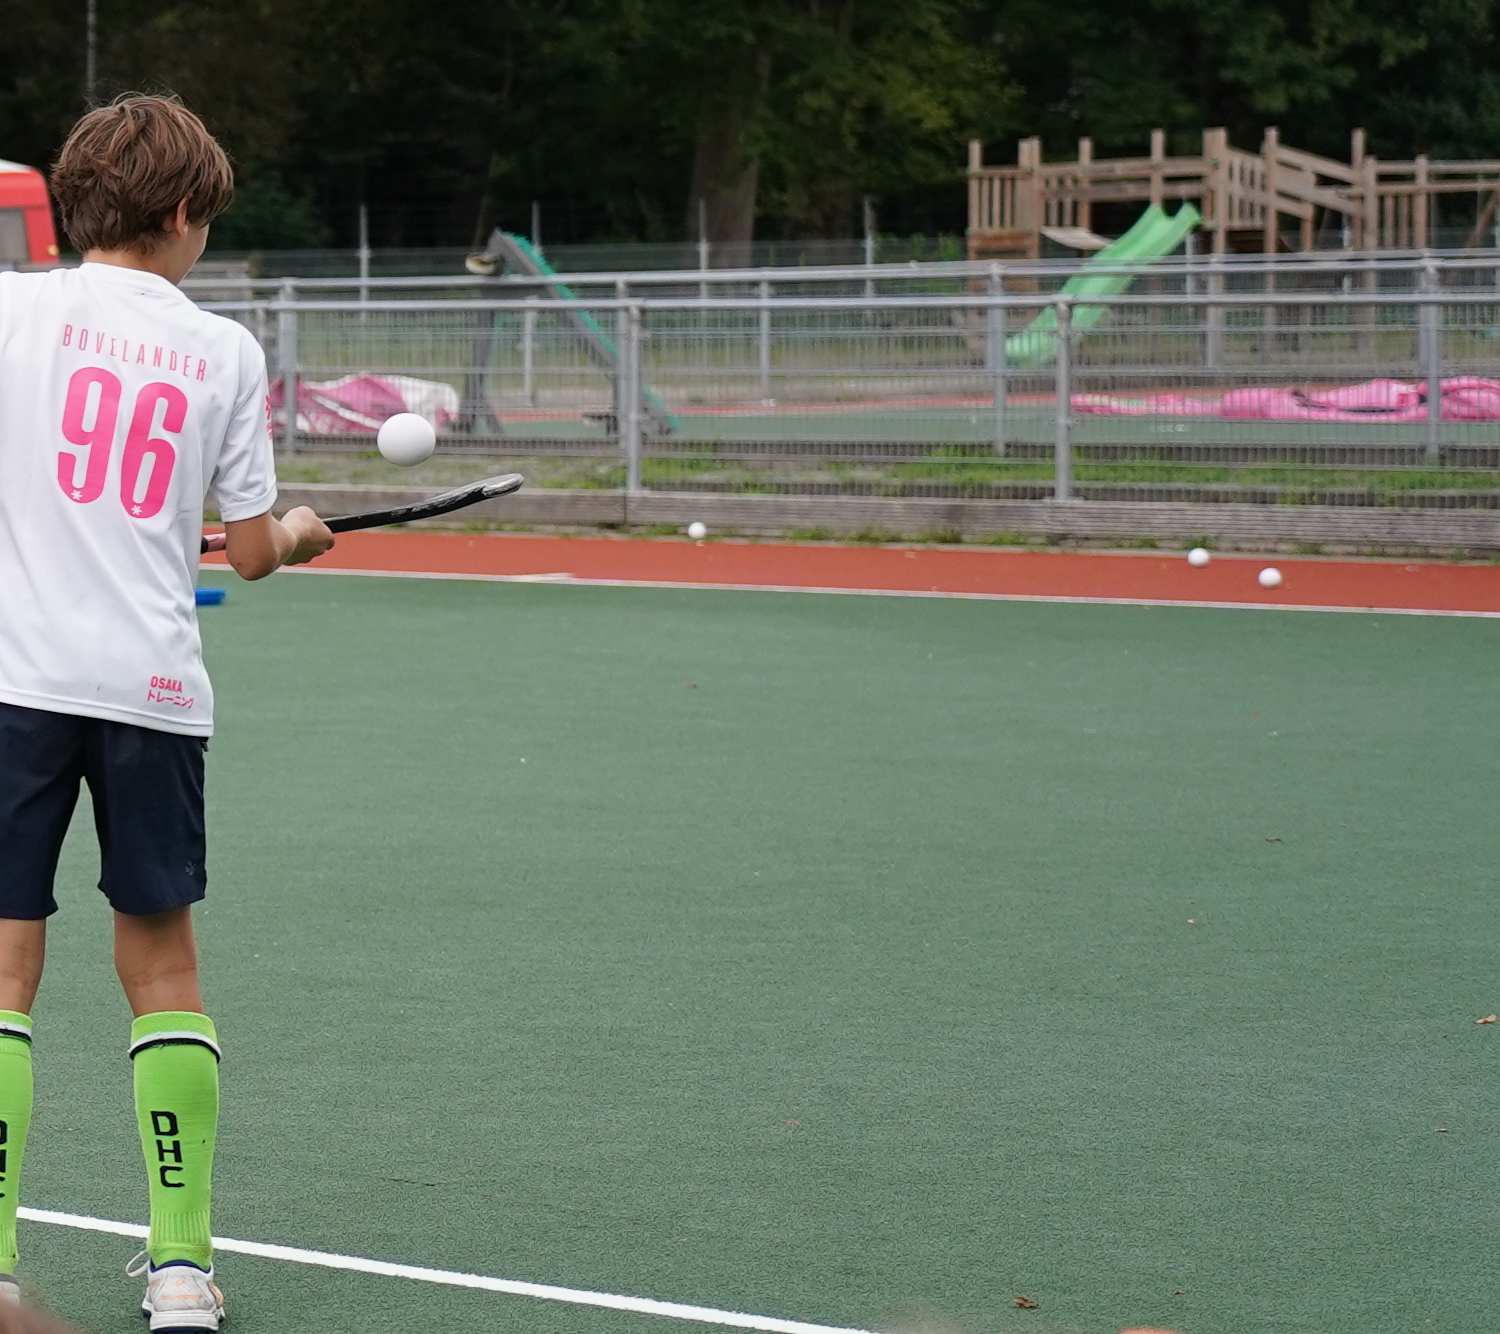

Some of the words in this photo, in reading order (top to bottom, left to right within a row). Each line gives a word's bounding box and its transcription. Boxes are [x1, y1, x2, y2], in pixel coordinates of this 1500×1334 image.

[62, 324, 207, 381] BOVELANDER
[57, 366, 188, 519] 96
[150, 676, 183, 693] OSAKA
[150, 1110, 185, 1189] DHC
